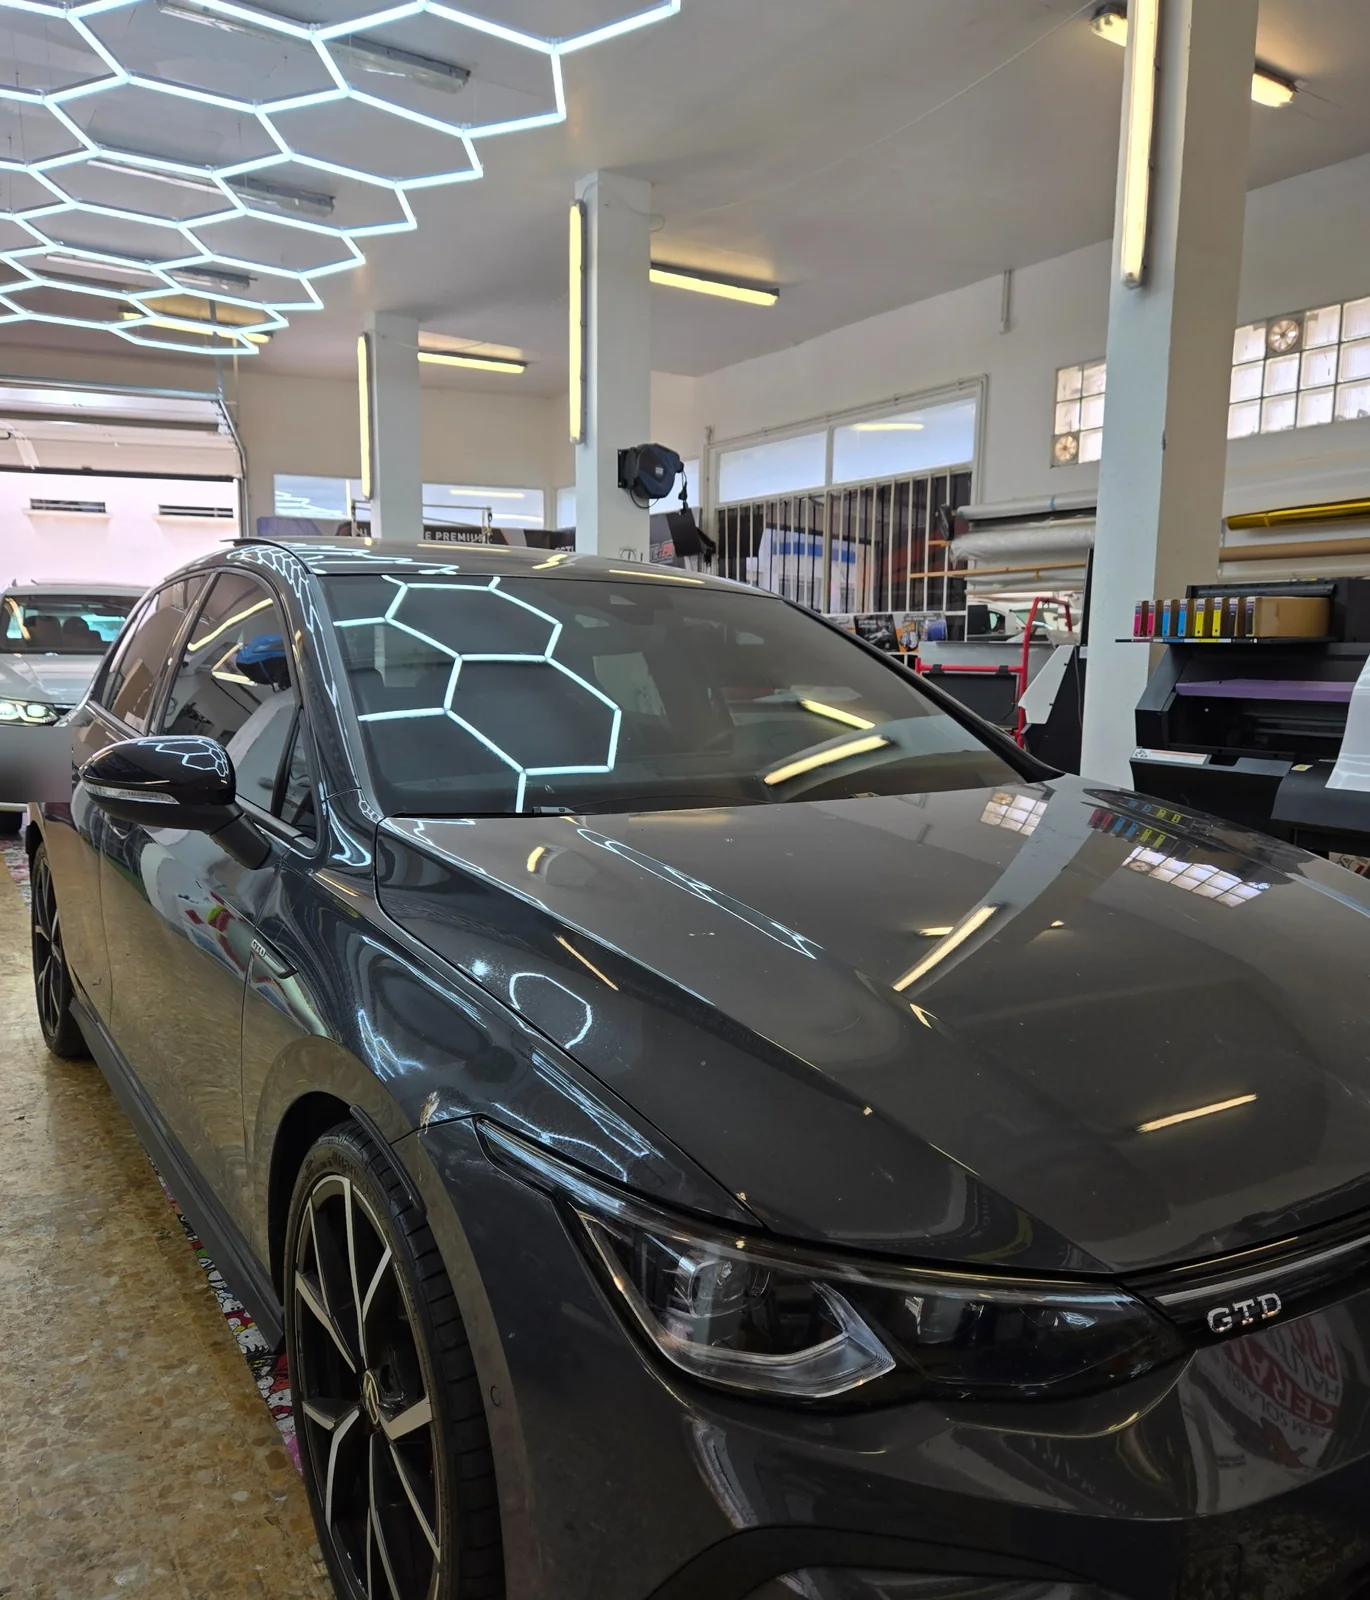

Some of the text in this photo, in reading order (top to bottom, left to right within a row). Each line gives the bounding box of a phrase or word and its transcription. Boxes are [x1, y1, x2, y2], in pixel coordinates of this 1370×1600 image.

[251, 938, 266, 957] GTD
[1207, 1292, 1282, 1333] GTD
[1222, 1338, 1333, 1424] CERA
